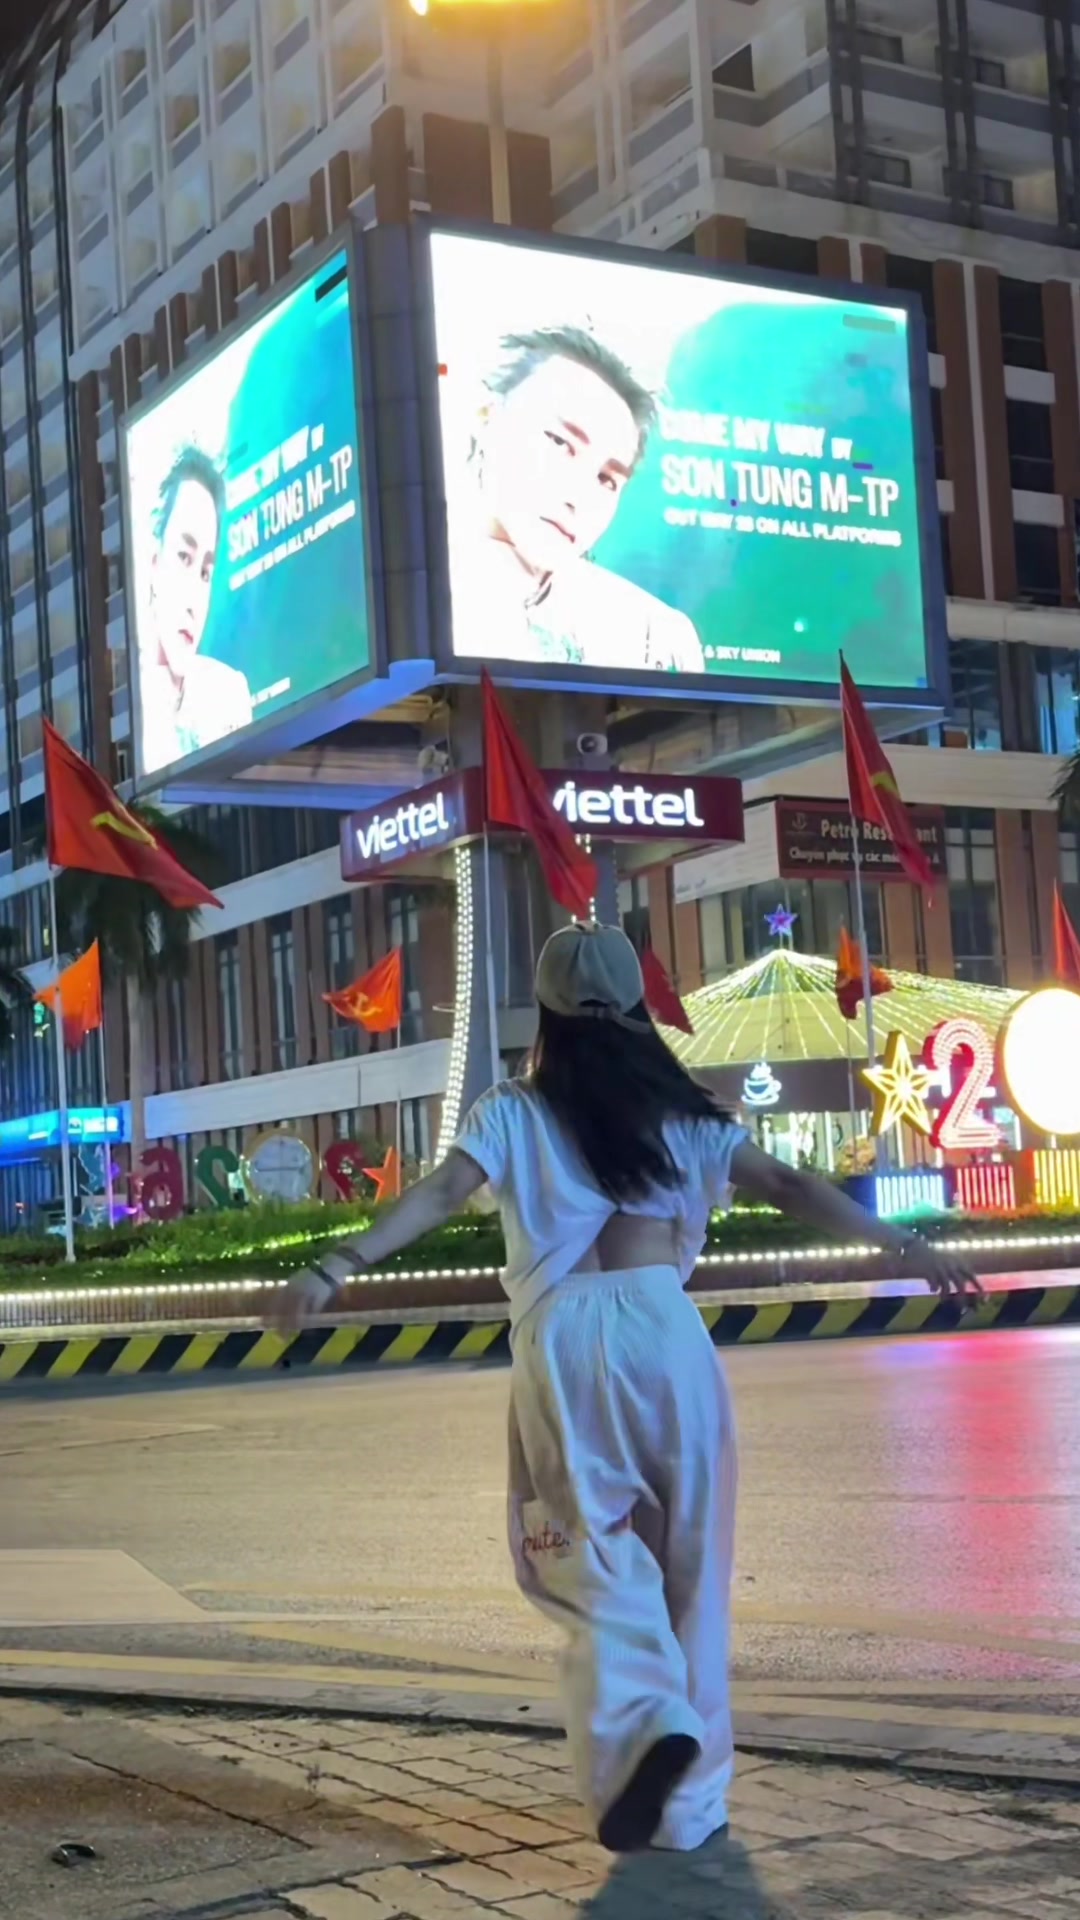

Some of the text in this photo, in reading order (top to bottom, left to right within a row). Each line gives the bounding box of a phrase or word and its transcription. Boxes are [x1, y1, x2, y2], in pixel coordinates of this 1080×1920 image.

[260, 478, 304, 541] TUNG
[306, 444, 353, 512] M-TP
[661, 453, 899, 517] SON TUNG M-TP
[782, 520, 811, 538] ALL
[356, 792, 449, 859] viettel
